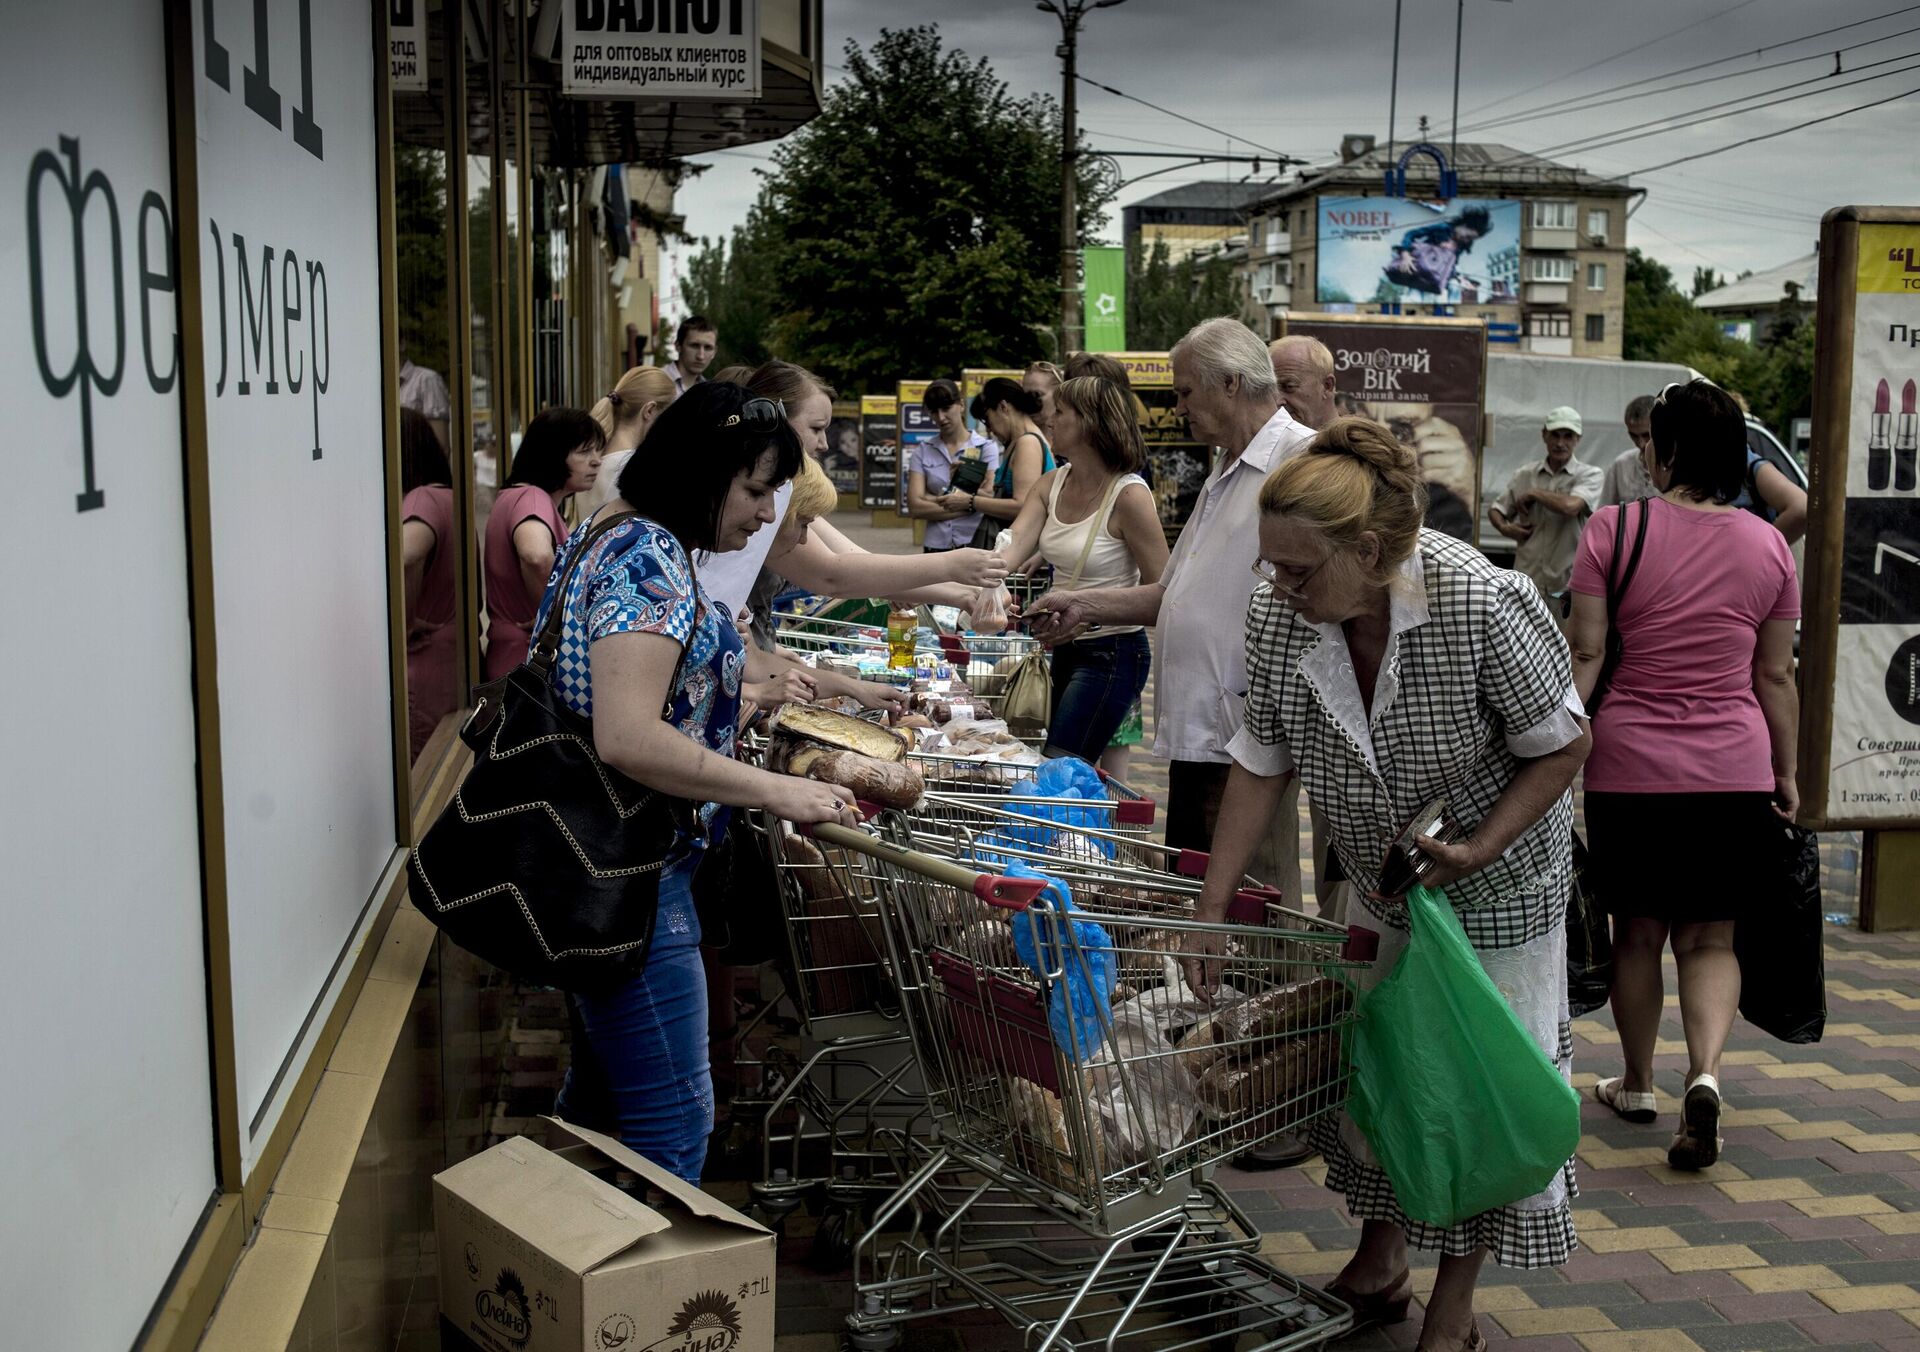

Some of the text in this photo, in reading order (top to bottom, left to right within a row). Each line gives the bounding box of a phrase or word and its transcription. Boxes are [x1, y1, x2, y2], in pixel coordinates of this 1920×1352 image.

[573, 45, 746, 64] для оптовых клиентов
[573, 63, 745, 88] индивидуальный курс
[1397, 391, 1430, 401] завод
[1857, 737, 1920, 753] Соверш
[1842, 790, 1847, 802] 1
[1910, 789, 1920, 802] 0
